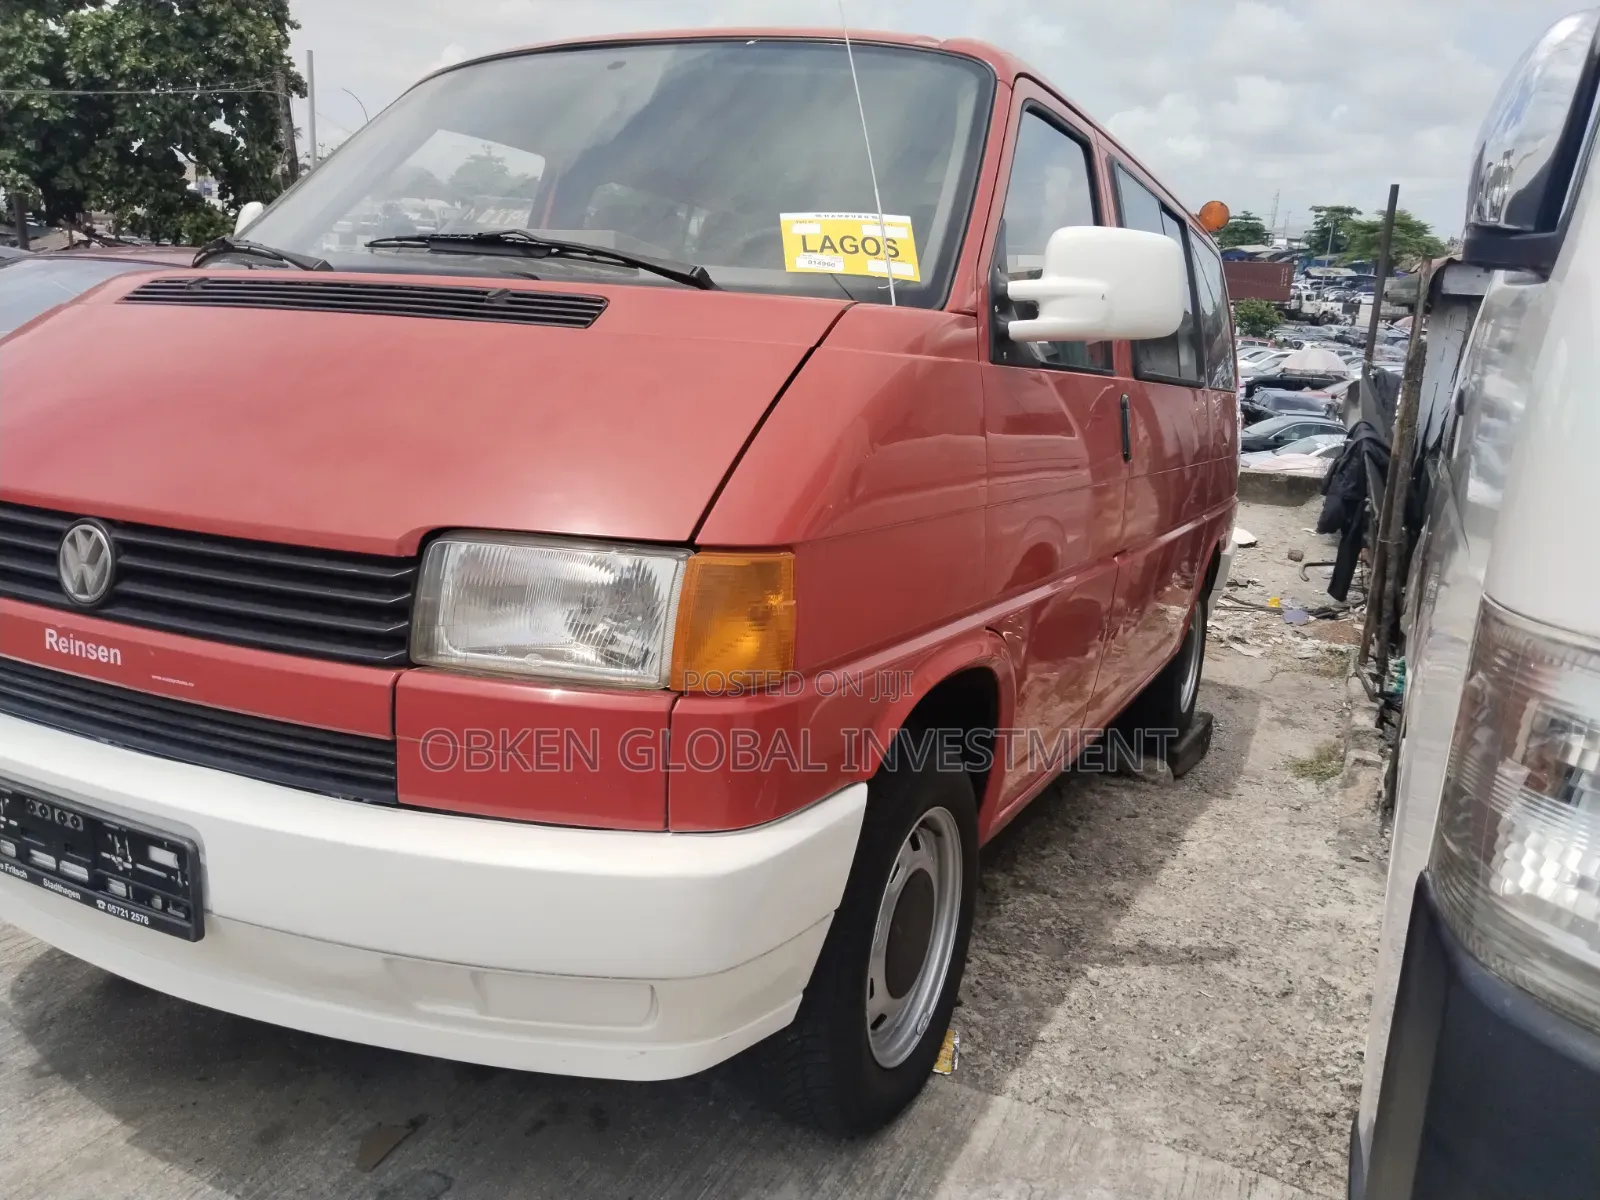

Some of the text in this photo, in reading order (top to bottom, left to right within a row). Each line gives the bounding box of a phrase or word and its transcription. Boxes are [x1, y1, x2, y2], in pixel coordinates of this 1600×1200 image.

[801, 234, 900, 258] LAGOS
[44, 627, 122, 666] Reinsen
[5, 864, 27, 879] Fritsch
[43, 878, 80, 900] Stadthagen
[107, 903, 129, 918] 05721
[130, 911, 149, 925] 2578
